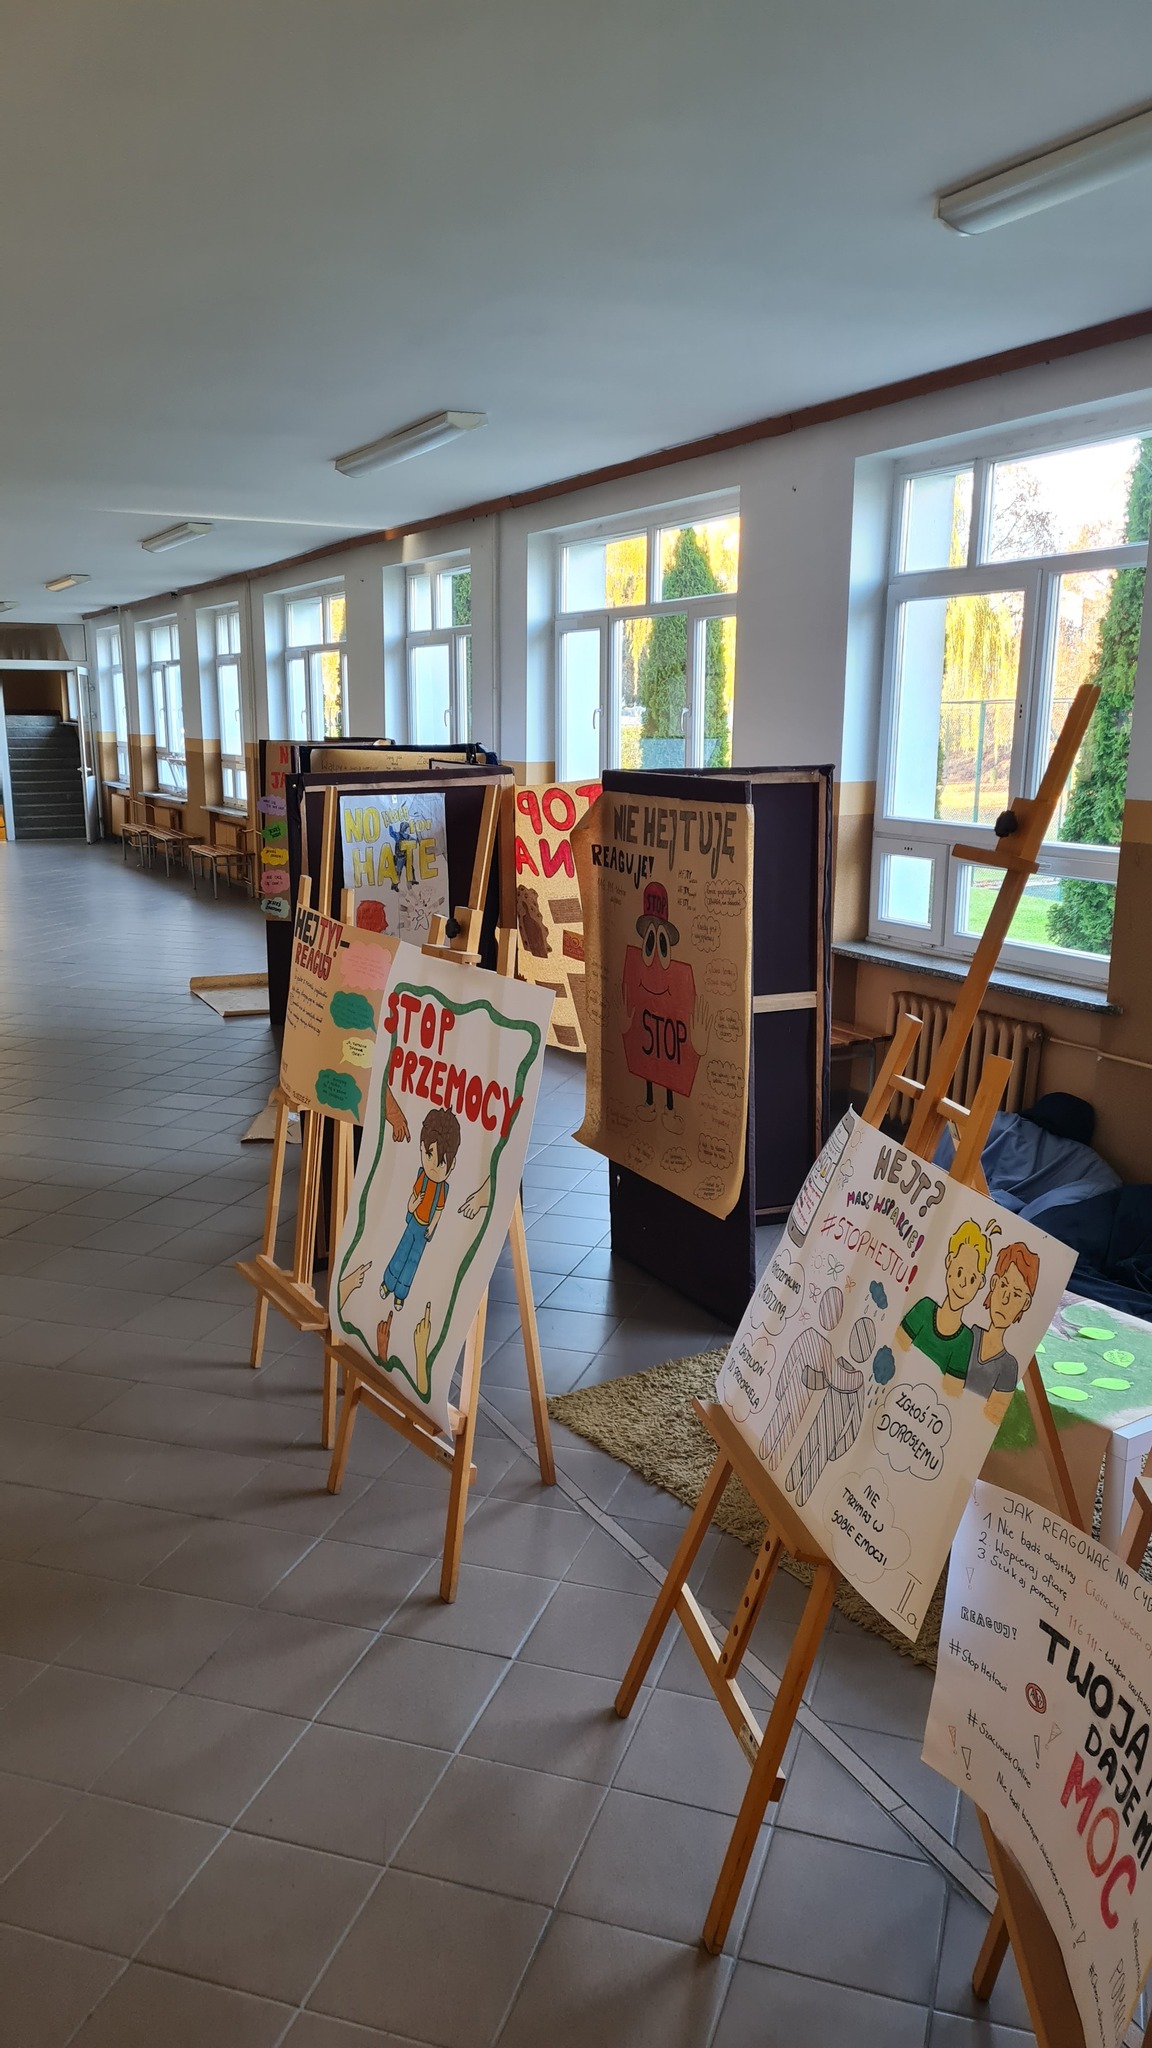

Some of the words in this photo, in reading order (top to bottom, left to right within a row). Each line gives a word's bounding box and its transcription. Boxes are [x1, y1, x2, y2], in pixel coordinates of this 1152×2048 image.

[344, 807, 381, 843] NO
[614, 804, 639, 844] NIE
[643, 806, 737, 879] HEJTUJĘ
[352, 838, 439, 888] HATE
[295, 908, 320, 947] HEJ
[646, 893, 668, 914] STOP
[295, 942, 332, 981] REAGUJ
[384, 992, 455, 1055] STOP
[642, 1009, 687, 1064] STOP
[388, 1046, 523, 1138] PRZEMOCY
[873, 1145, 946, 1217] HEJT?
[820, 1213, 918, 1292] #STOPHEJTU!
[873, 1195, 925, 1258] WSPARCIE!
[733, 1366, 760, 1409] PRZYJACIELA
[896, 1392, 930, 1423] ZGŁOŚ
[927, 1413, 943, 1434] TO
[877, 1414, 939, 1469] DOROSŁEMU
[842, 1487, 872, 1524] TRZYMAJ
[872, 1520, 884, 1532] W
[864, 1485, 880, 1509] NIE
[831, 1510, 855, 1537] SOBIE
[854, 1533, 888, 1566] EMOCJI
[998, 1517, 1014, 1539] Nie
[1044, 1553, 1077, 1585] obojętny
[1003, 1497, 1035, 1524] JAK
[1042, 1516, 1110, 1572] REAGOWAĆ
[1115, 1568, 1129, 1590] NA
[995, 1539, 1039, 1580] Wspieraj
[1042, 1574, 1067, 1601] ofiarę
[960, 1606, 1017, 1640] REAGUJ!
[1029, 1584, 1059, 1617] pomocy
[1113, 1610, 1142, 1642] wspiera
[1068, 1615, 1083, 1636] 116
[1087, 1633, 1098, 1652] 111
[1105, 1651, 1126, 1681] telefon
[1039, 1618, 1150, 1775] TWOJA
[996, 1771, 1008, 1793] Nie
[1085, 1723, 1141, 1828] DAJE
[1060, 1751, 1137, 1930] MOC
